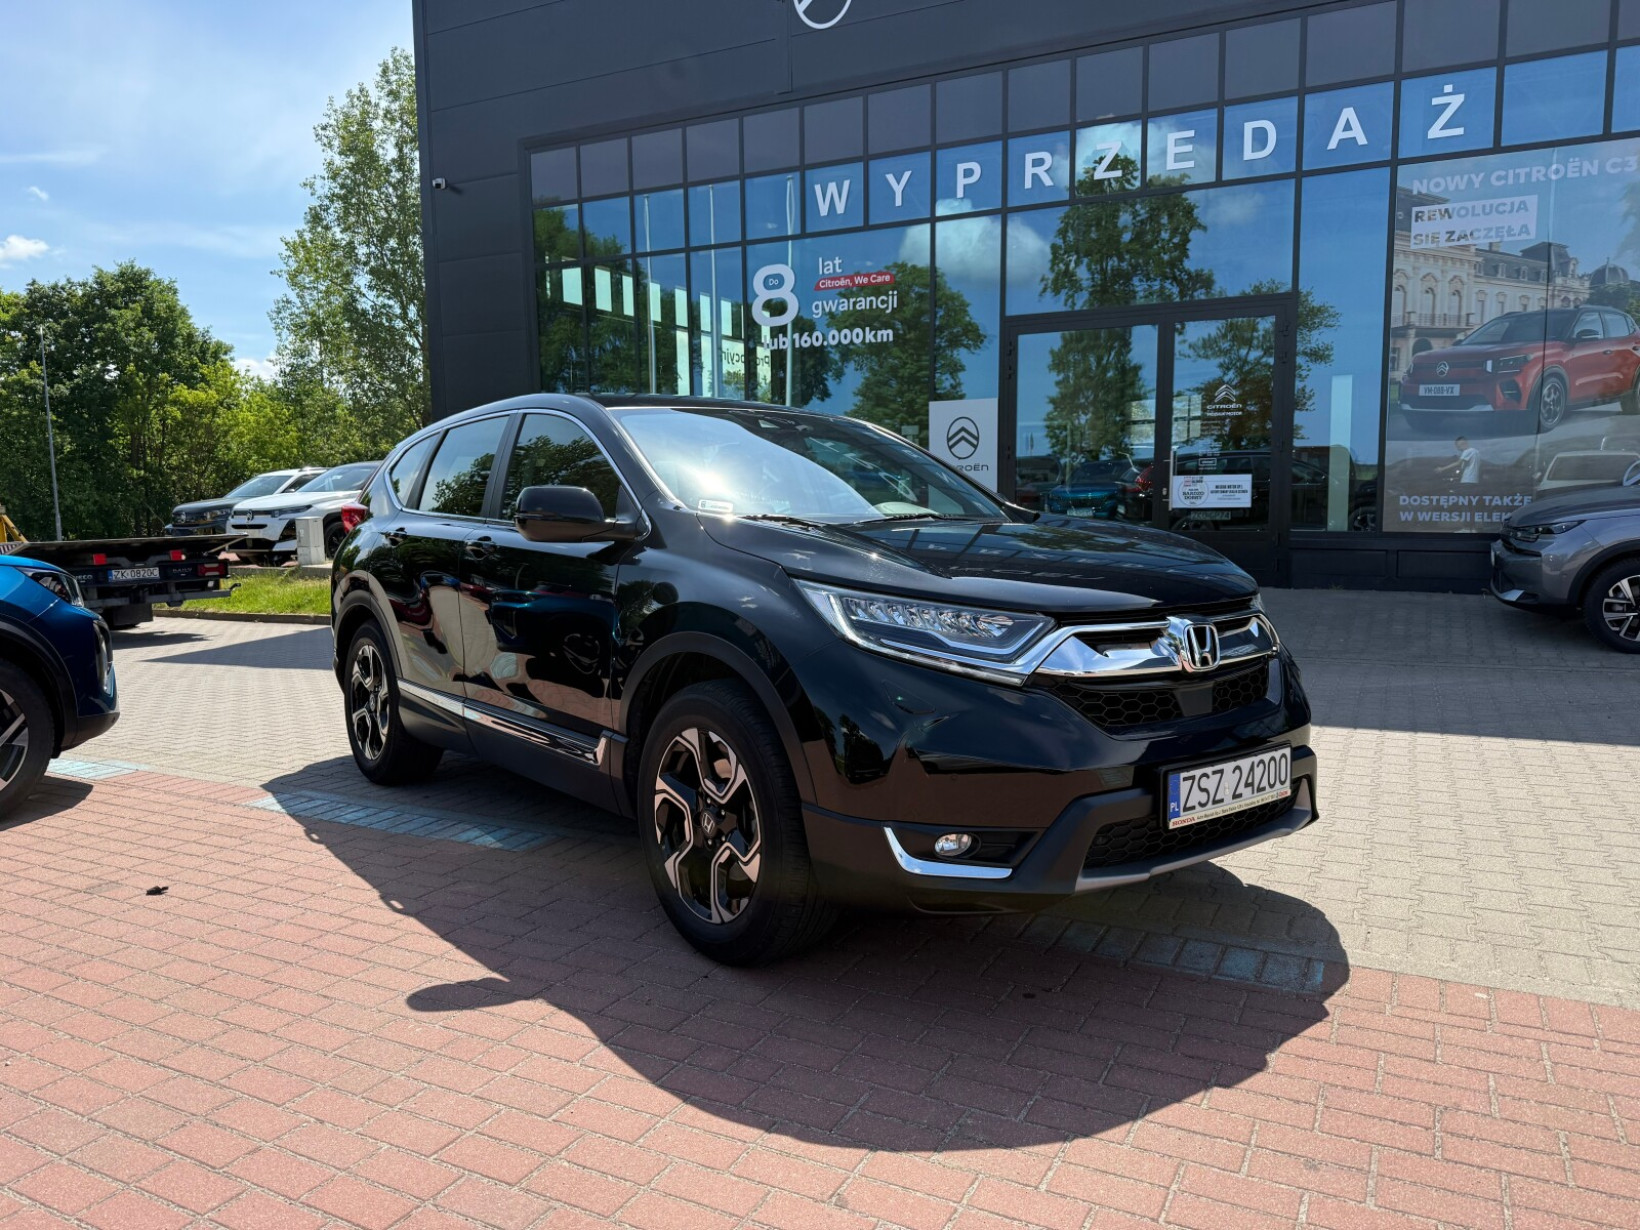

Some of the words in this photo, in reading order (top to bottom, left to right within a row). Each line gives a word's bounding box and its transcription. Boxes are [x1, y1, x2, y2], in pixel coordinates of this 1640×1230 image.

[813, 84, 1466, 217] WYPRZEDAŻ
[1412, 172, 1486, 196] NOWY
[1490, 156, 1599, 187] CITROËN
[1605, 155, 1638, 175] C3
[1414, 199, 1530, 223] REWOLUCJA
[1413, 231, 1441, 247] SIĘ
[1445, 223, 1531, 244] ZACZĘŁA
[818, 256, 842, 275] lat
[768, 278, 779, 286] Do
[819, 278, 853, 288] Citroën,
[854, 275, 869, 285] We
[870, 274, 891, 283] Care
[752, 263, 799, 327] 8
[812, 290, 898, 318] gwarancji
[763, 333, 789, 351] lub
[1399, 495, 1480, 509] DOSTĘPNY
[1482, 492, 1533, 506] TAKŻE
[1400, 511, 1414, 521] W
[1417, 511, 1471, 522] WERSJI
[113, 570, 127, 579] ZK
[1169, 802, 1179, 812] PL
[1182, 768, 1224, 813] ZSZ
[1231, 752, 1288, 800] 24200
